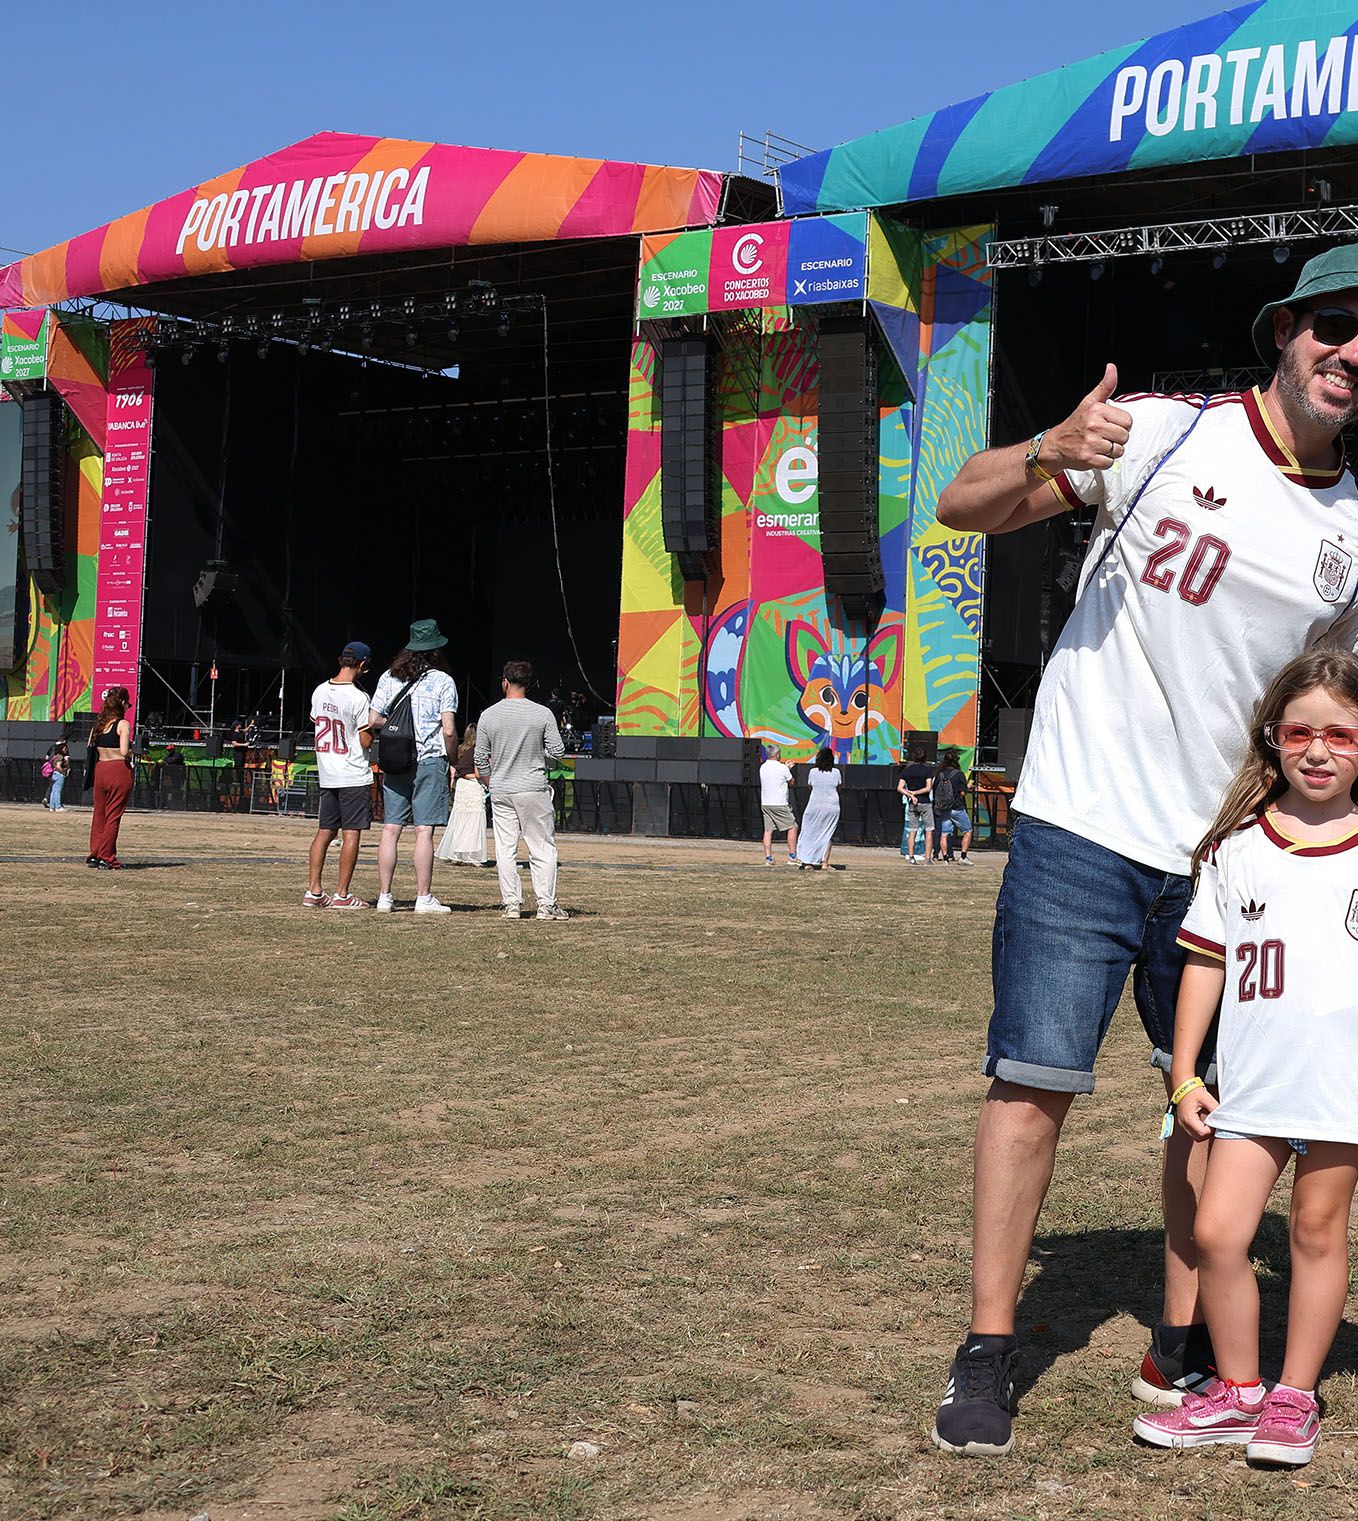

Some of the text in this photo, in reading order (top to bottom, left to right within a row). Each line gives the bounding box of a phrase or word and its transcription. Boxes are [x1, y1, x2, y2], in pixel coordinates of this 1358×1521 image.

[175, 166, 431, 255] PORTAMÉRICA
[801, 258, 853, 271] ESCENARIO
[651, 269, 698, 282] ESCENARIO
[663, 282, 706, 297] Xacobeo
[724, 277, 770, 291] CONCERTOS
[724, 289, 769, 302] DO XACOBEO
[663, 300, 684, 312] 2027
[14, 354, 45, 366] Xacobeo
[16, 368, 30, 377] 2027
[115, 391, 144, 409] 1906
[756, 512, 819, 528] esmerar
[1140, 516, 1233, 606] 20
[322, 702, 339, 714] PEDRI
[315, 715, 349, 756] 20
[1235, 938, 1286, 1003] 20
